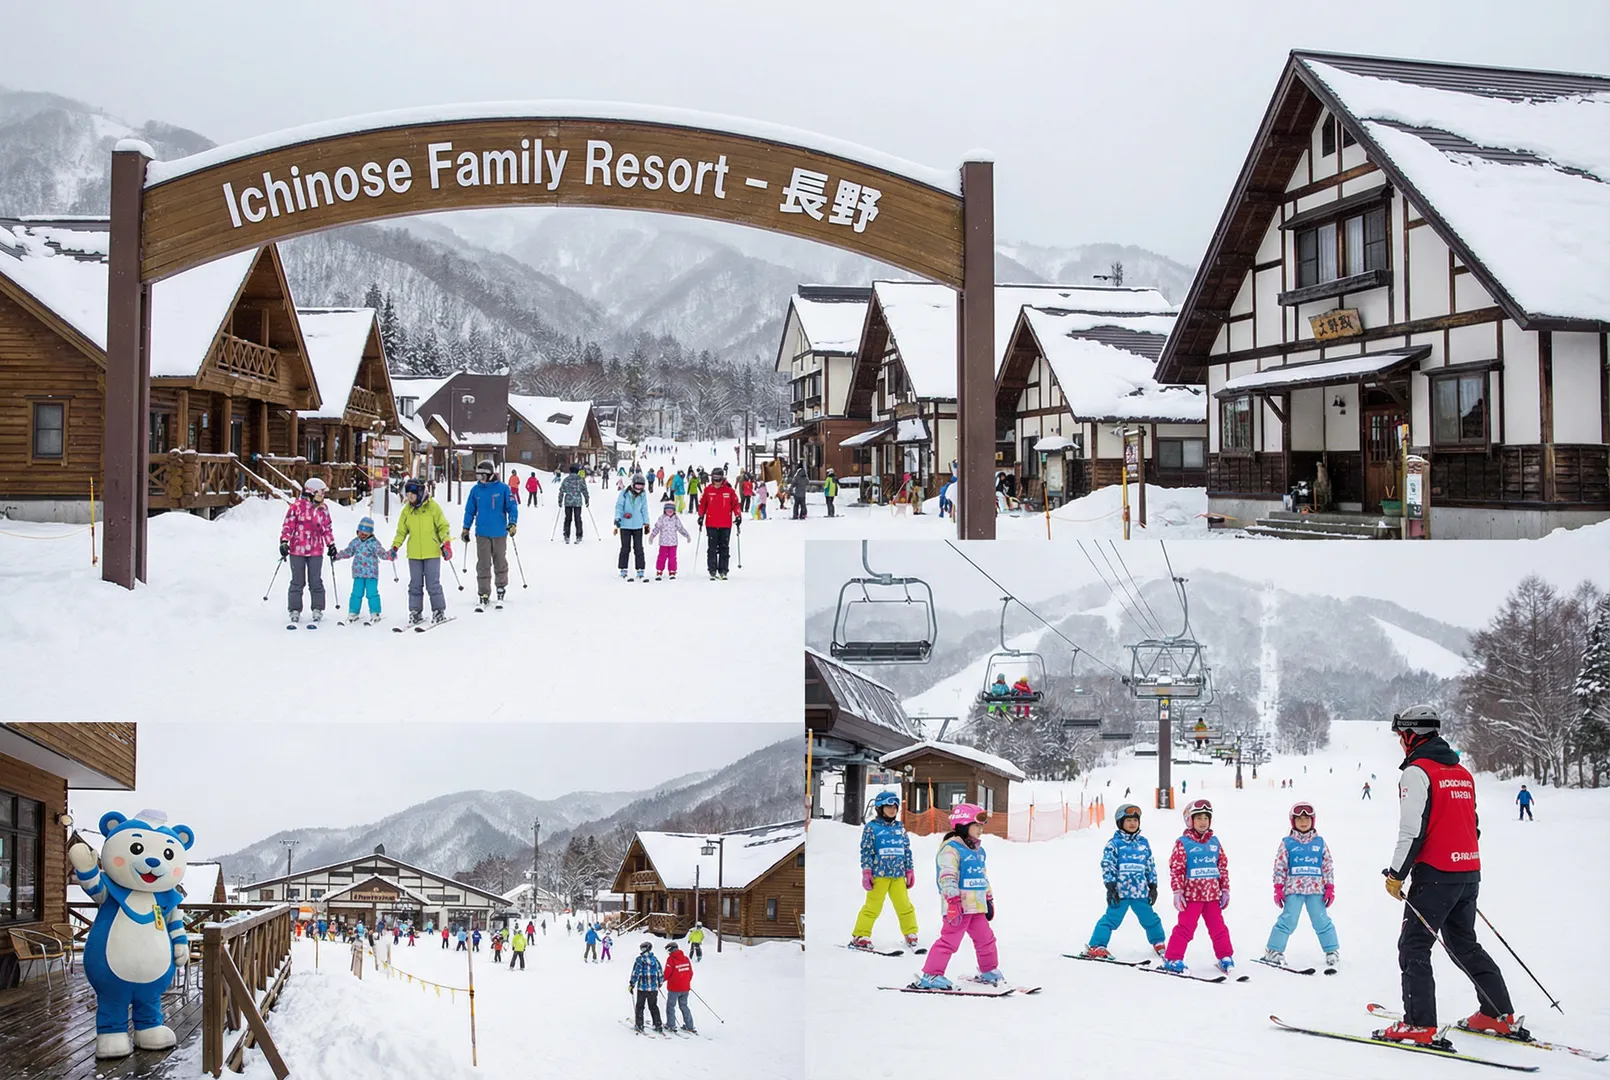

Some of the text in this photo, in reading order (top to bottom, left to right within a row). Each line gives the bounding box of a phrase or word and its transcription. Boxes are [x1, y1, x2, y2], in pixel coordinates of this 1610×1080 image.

[223, 159, 413, 228] Ichinose
[427, 138, 569, 191] Family
[585, 139, 730, 199] Resort
[779, 167, 883, 233] 長野
